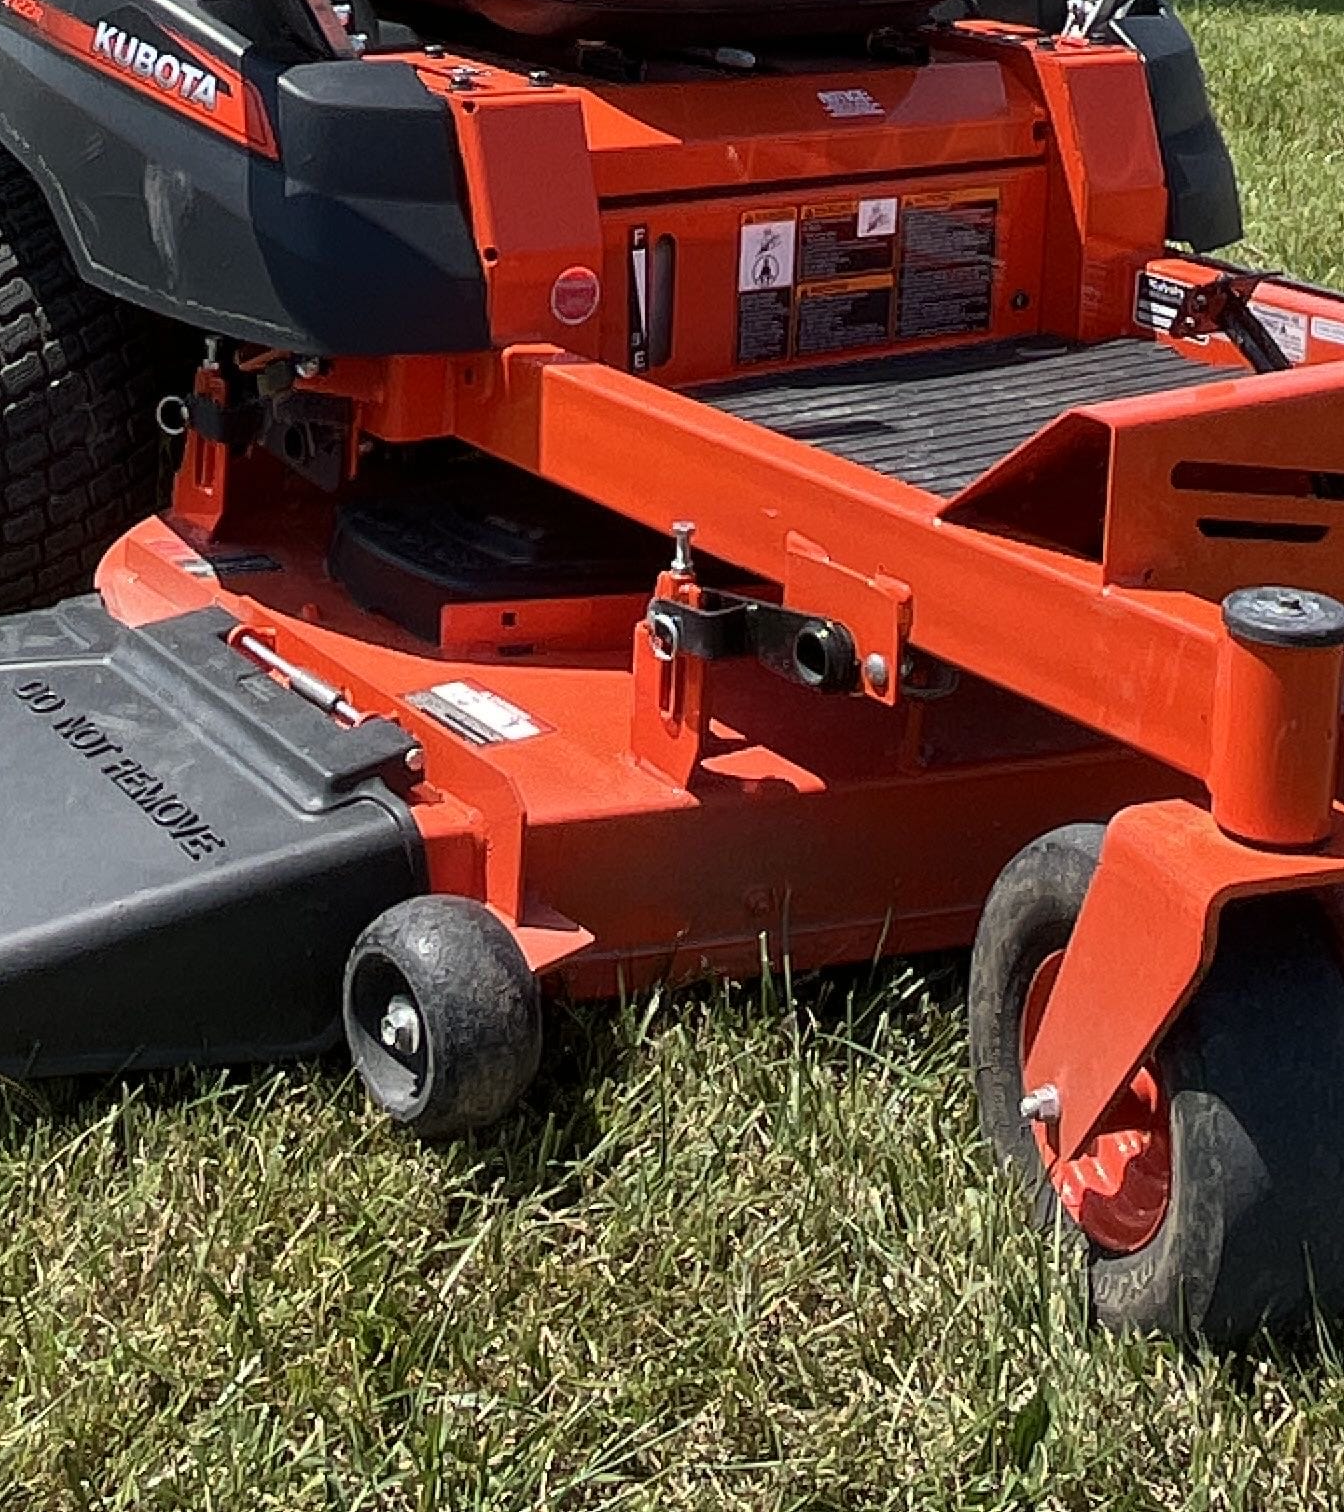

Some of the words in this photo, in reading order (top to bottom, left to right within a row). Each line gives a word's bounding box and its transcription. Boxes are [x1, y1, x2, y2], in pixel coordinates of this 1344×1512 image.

[92, 21, 220, 111] KUBOTA
[634, 228, 646, 246] F
[634, 351, 646, 368] E
[14, 679, 67, 713] DO
[53, 714, 123, 759] NOT
[101, 758, 227, 862] REMOVE
